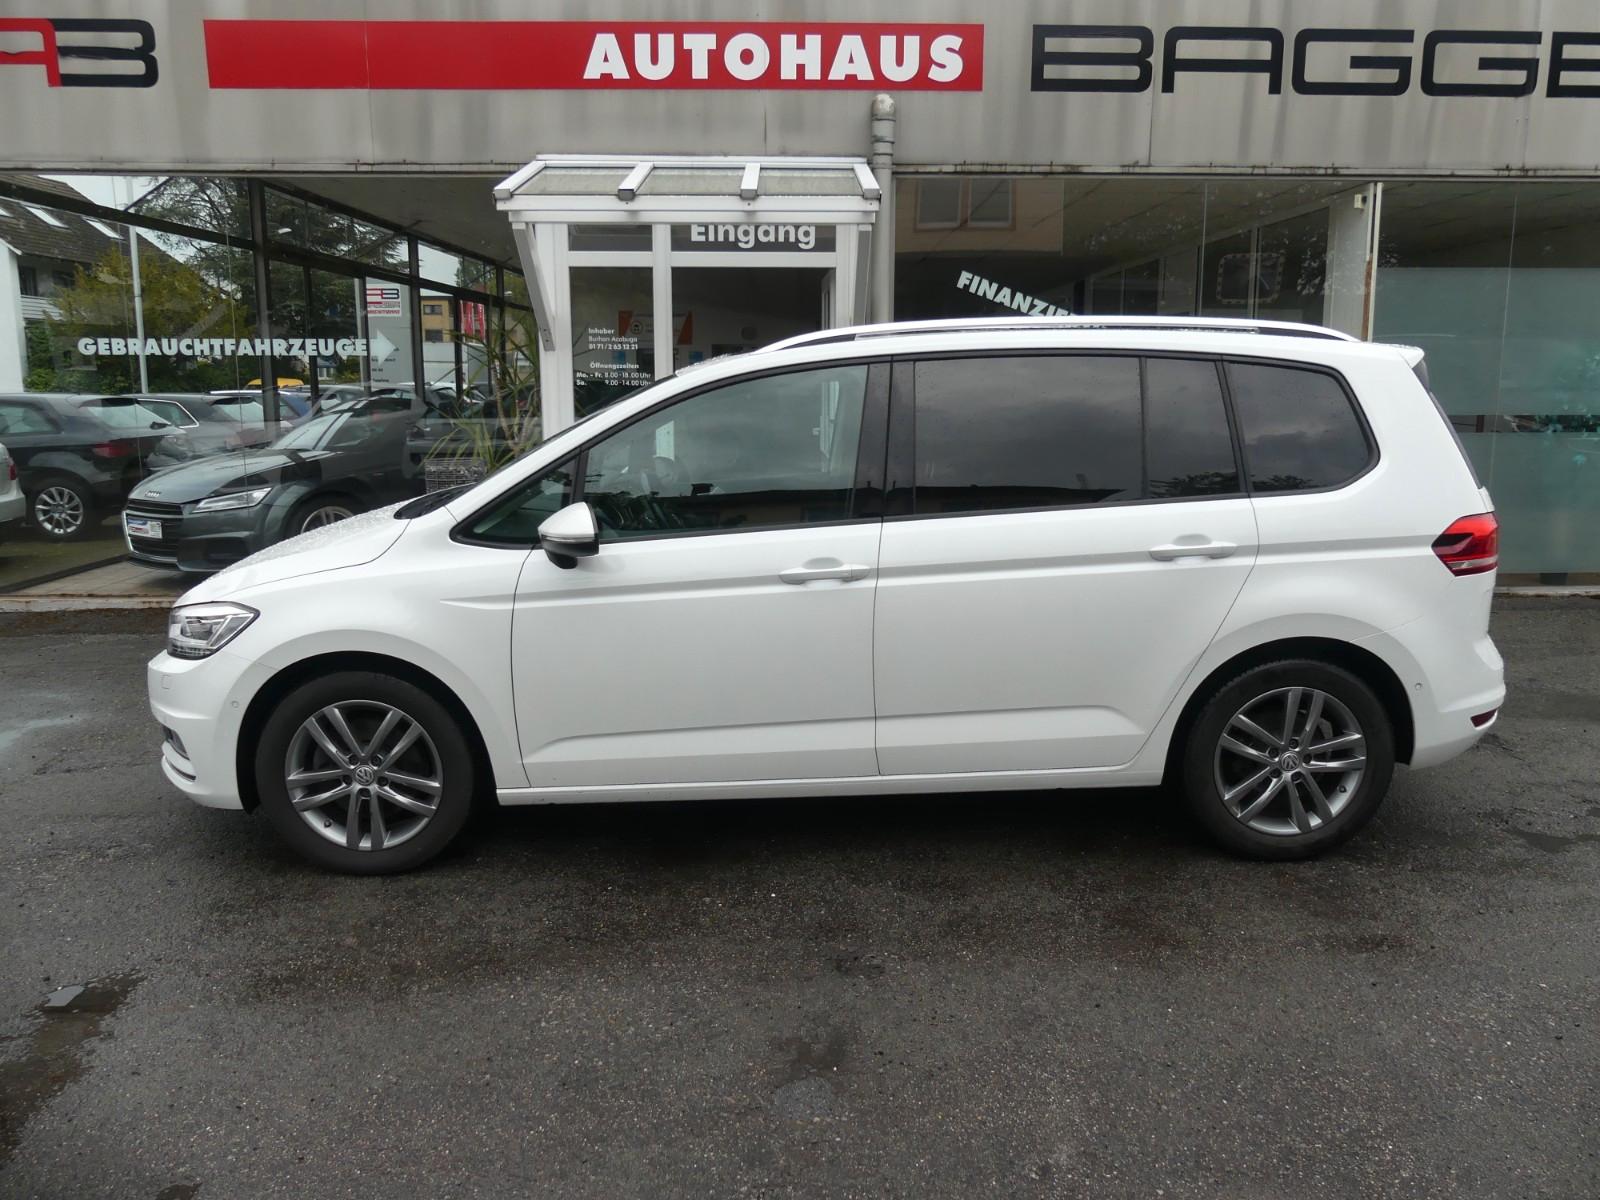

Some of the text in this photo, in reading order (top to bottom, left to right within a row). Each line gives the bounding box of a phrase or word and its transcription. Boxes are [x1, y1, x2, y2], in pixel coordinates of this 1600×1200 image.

[583, 33, 964, 83] AUTOHAUS
[691, 223, 816, 250] Eingang
[78, 337, 368, 356] GEBRAUCHTFAHRZEUGE
